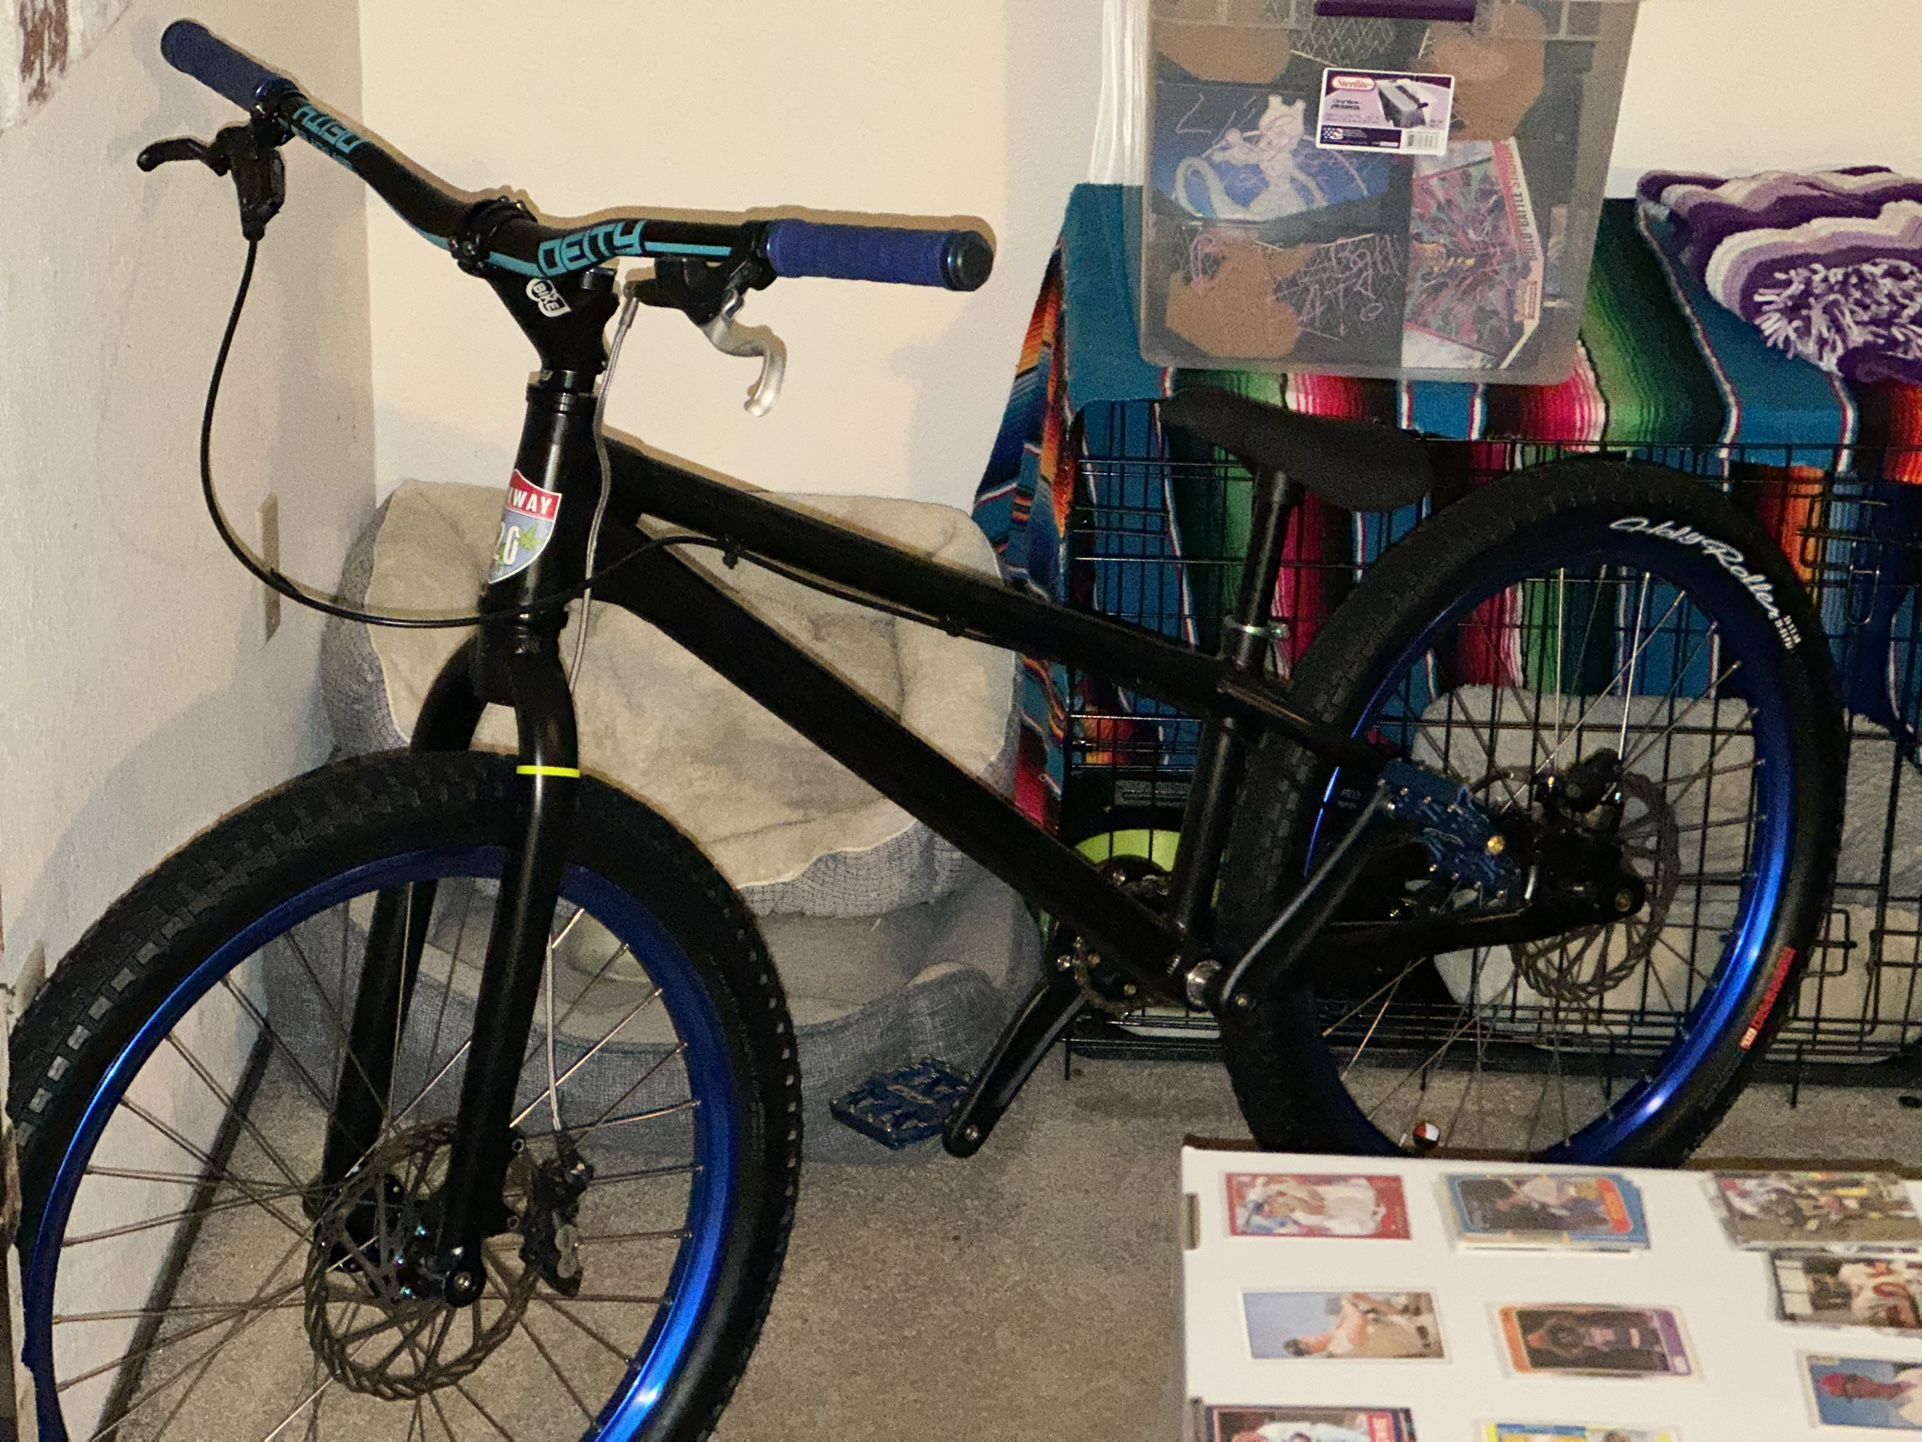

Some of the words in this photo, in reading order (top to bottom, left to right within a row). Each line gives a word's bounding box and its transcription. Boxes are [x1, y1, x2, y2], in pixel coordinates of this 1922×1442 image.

[538, 219, 648, 277] DEITY
[531, 280, 561, 313] BIKE
[1701, 539, 1781, 621] Roller
